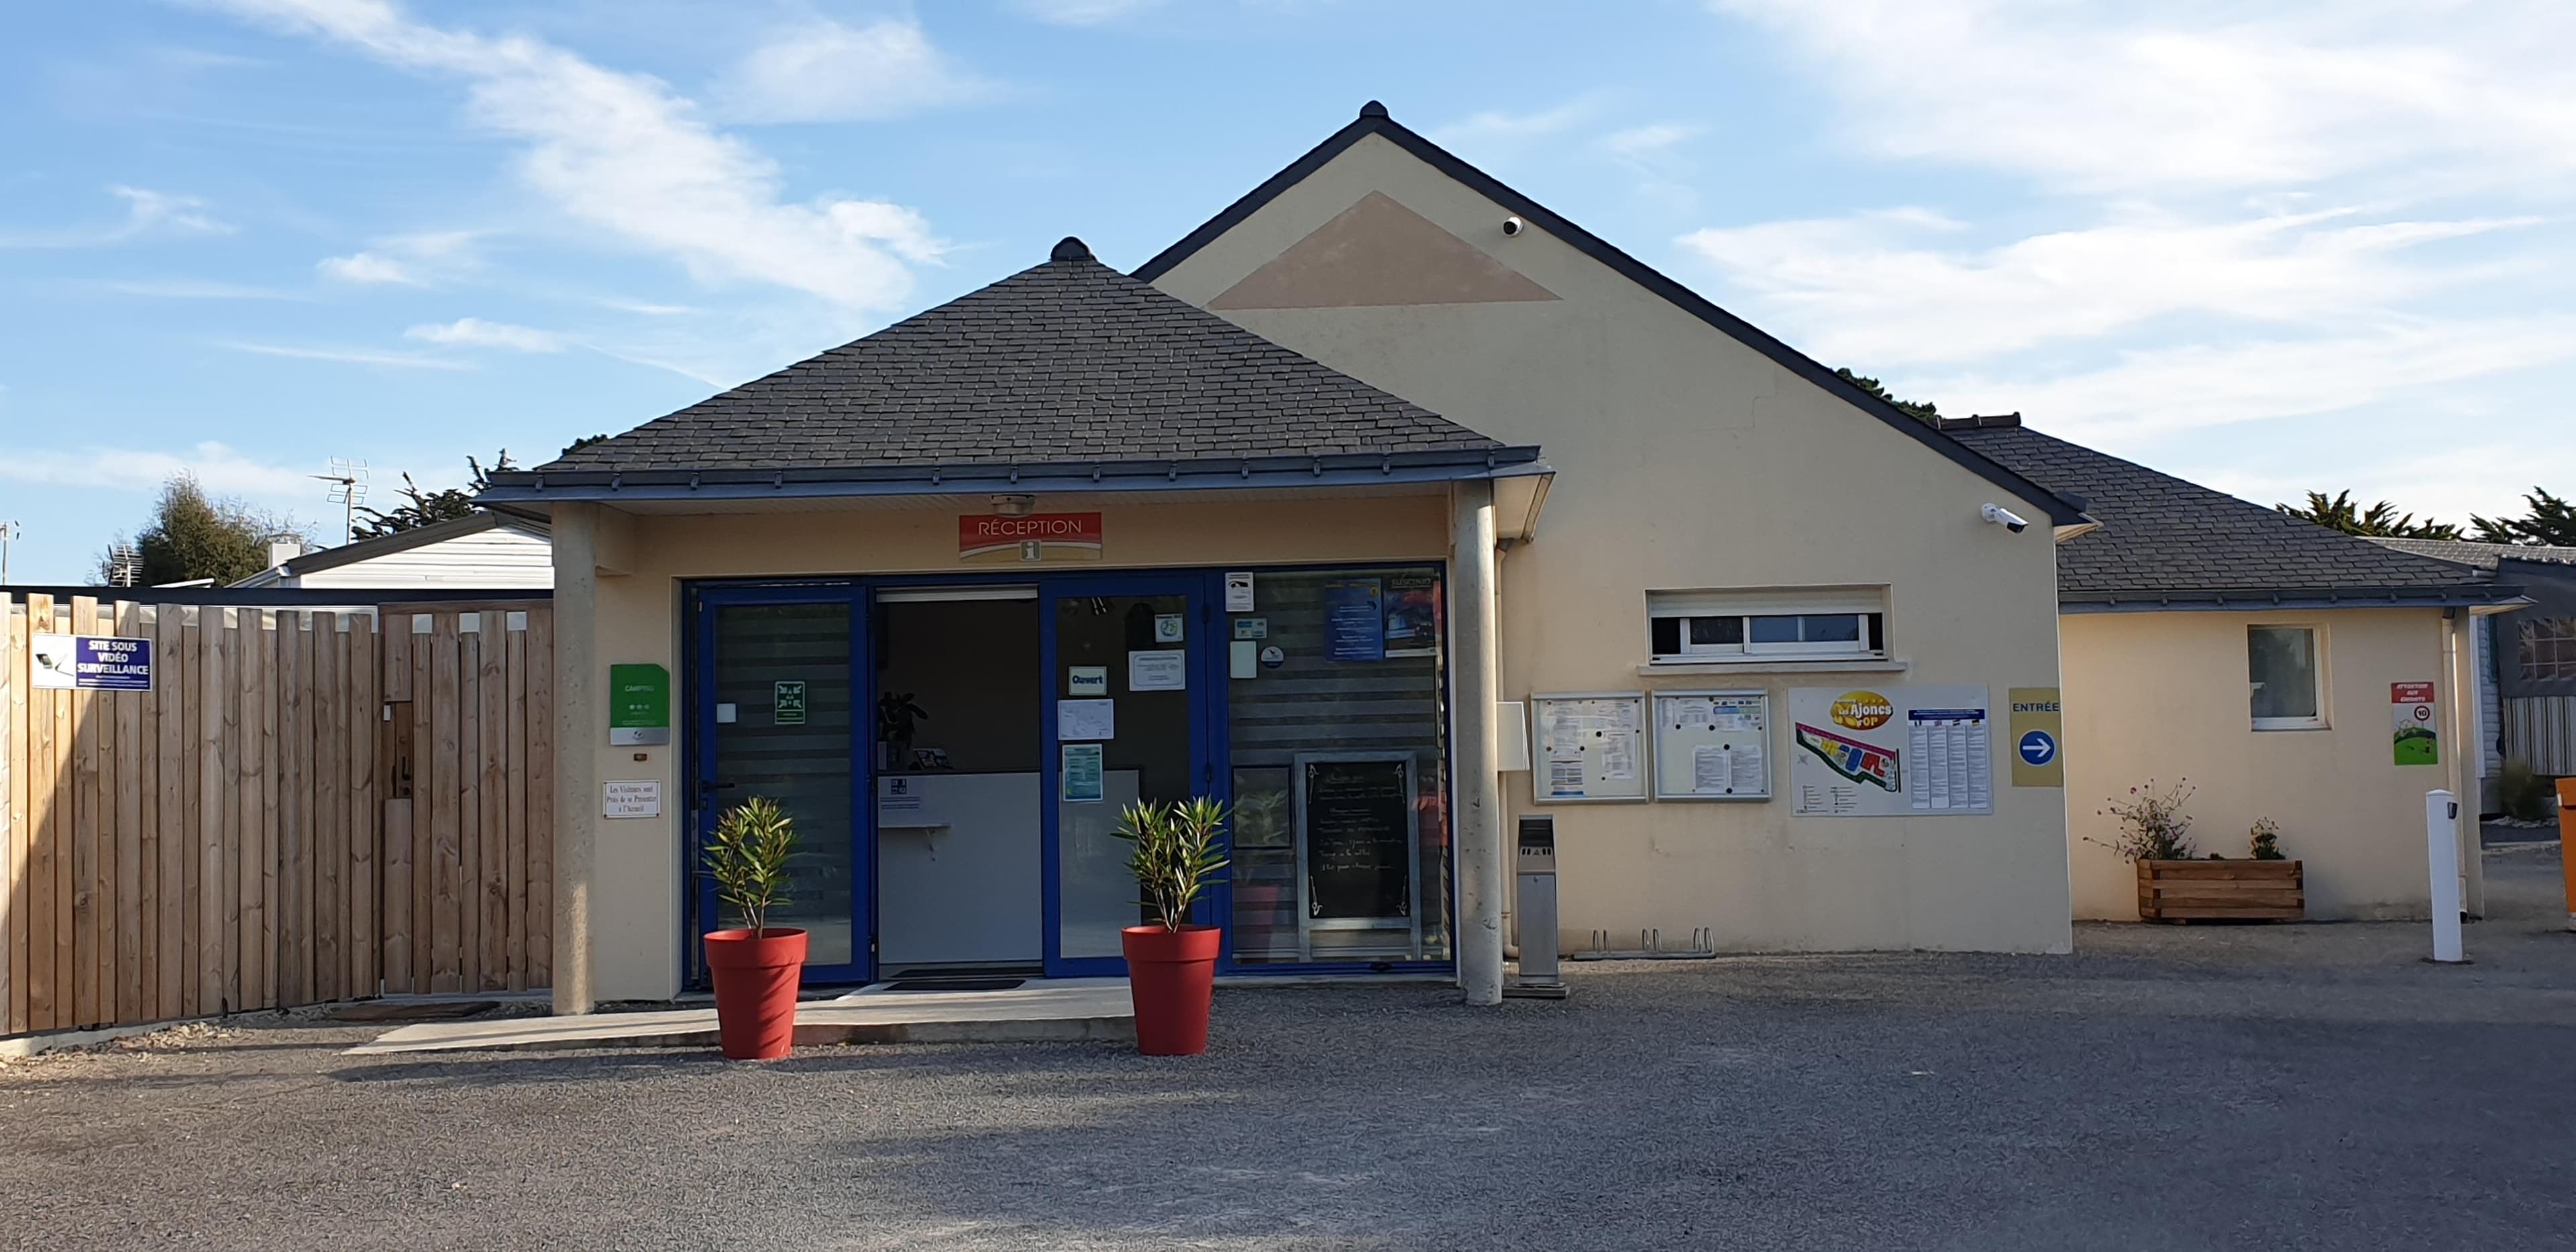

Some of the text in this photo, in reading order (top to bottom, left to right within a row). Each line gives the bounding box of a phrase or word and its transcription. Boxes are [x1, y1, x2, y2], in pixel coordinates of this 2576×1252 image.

[978, 519, 1081, 535] RÉCEPTION
[89, 640, 138, 652] SITE SOUS
[97, 652, 129, 663] VIDÉO
[77, 663, 149, 675] SURVEILLANCE
[1072, 675, 1103, 684] Ouvert
[1851, 703, 1892, 718] Ajoncs
[2013, 701, 2059, 712] ENTRÉE
[610, 785, 619, 793] Les
